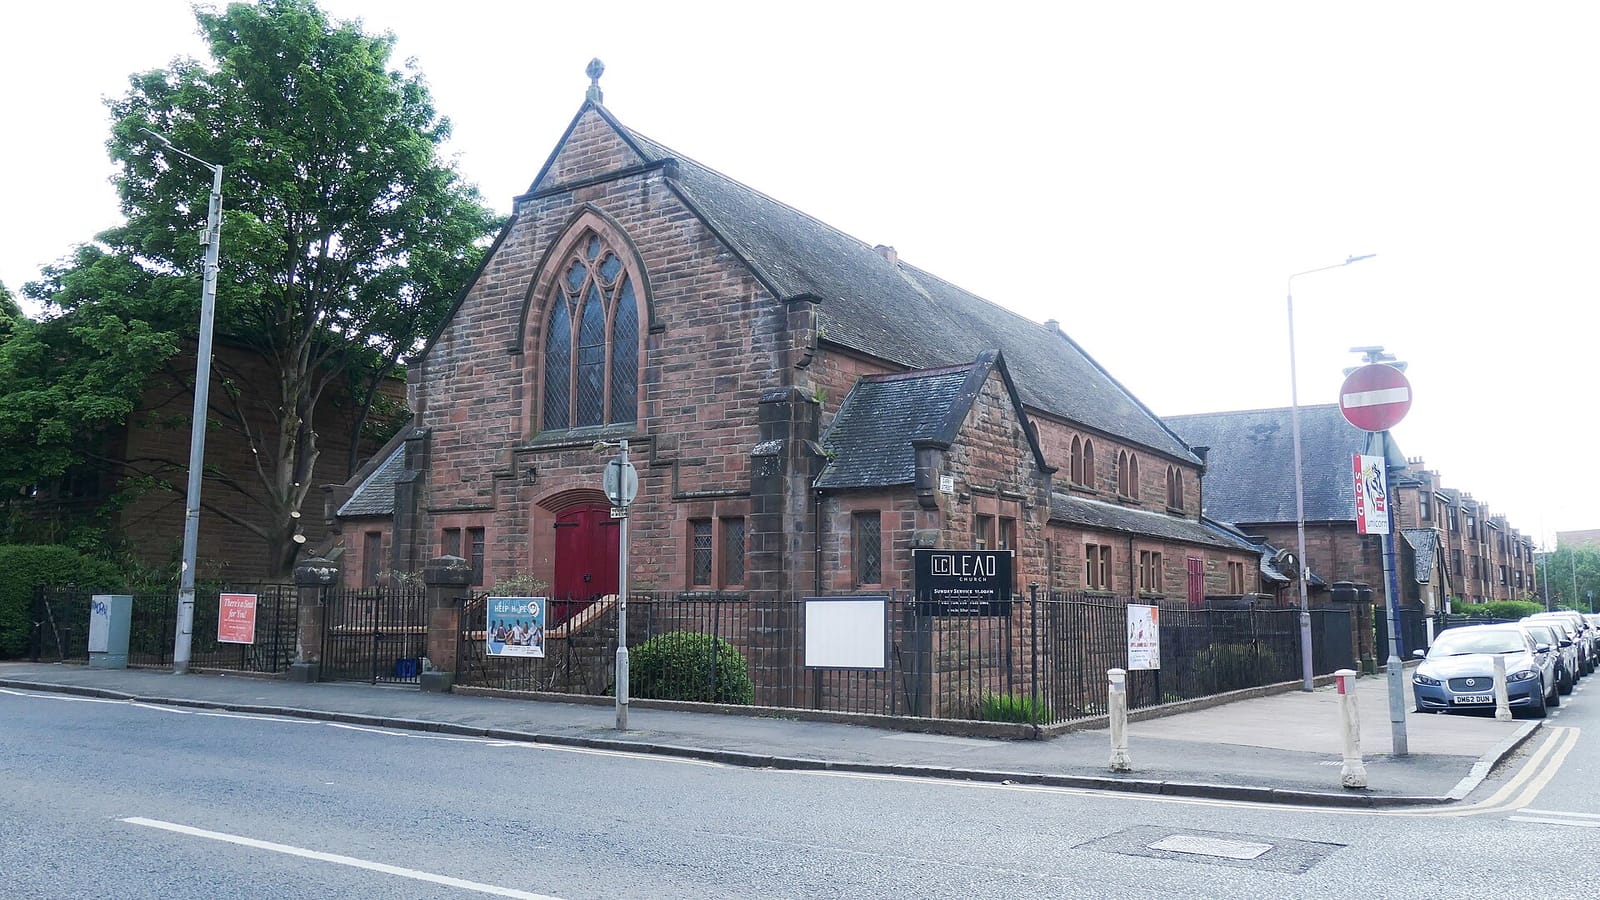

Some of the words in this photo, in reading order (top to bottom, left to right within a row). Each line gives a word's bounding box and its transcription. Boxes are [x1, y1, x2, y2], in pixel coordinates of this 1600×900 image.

[1355, 472, 1364, 516] SOLD
[935, 559, 948, 573] LC
[952, 555, 996, 576] LEAD
[494, 605, 509, 613] HELP
